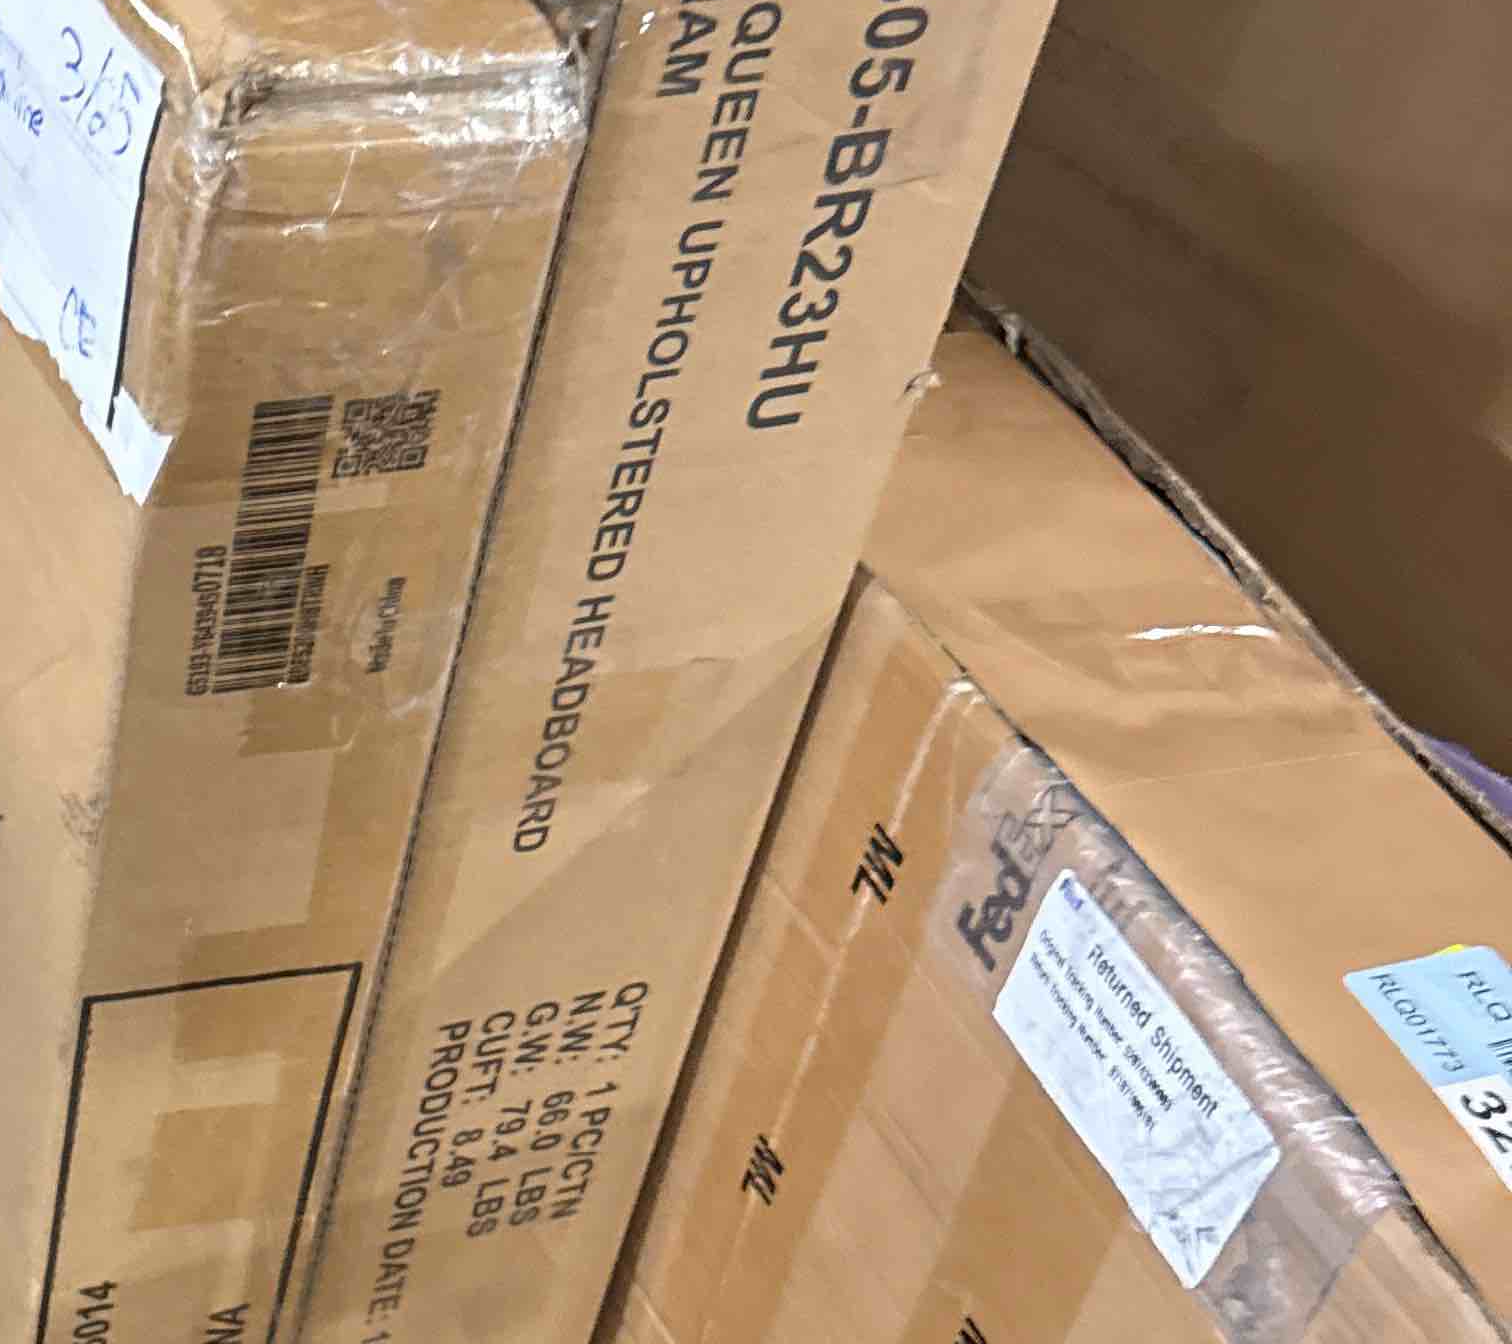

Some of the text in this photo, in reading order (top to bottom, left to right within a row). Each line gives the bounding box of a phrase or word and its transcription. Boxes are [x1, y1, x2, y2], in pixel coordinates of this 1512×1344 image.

[690, 1, 782, 202] QUEEN
[587, 220, 724, 582] UPHOLSTERED
[512, 593, 617, 855] HEADBOARD
[1088, 943, 1152, 1030] Returned
[1149, 1024, 1221, 1119] Shipment
[1368, 971, 1466, 1073] RLQ01773
[388, 1019, 473, 1234] PRODUCTION
[440, 1009, 516, 1192] CUFT: 8.49
[487, 1100, 532, 1163] 79.4
[529, 1090, 576, 1152] 66.0
[585, 1079, 620, 1098] 1
[465, 1176, 511, 1239] LBS
[508, 1167, 552, 1227] LBS
[548, 1106, 613, 1220] PC/CTN
[361, 1236, 417, 1326] DATE:
